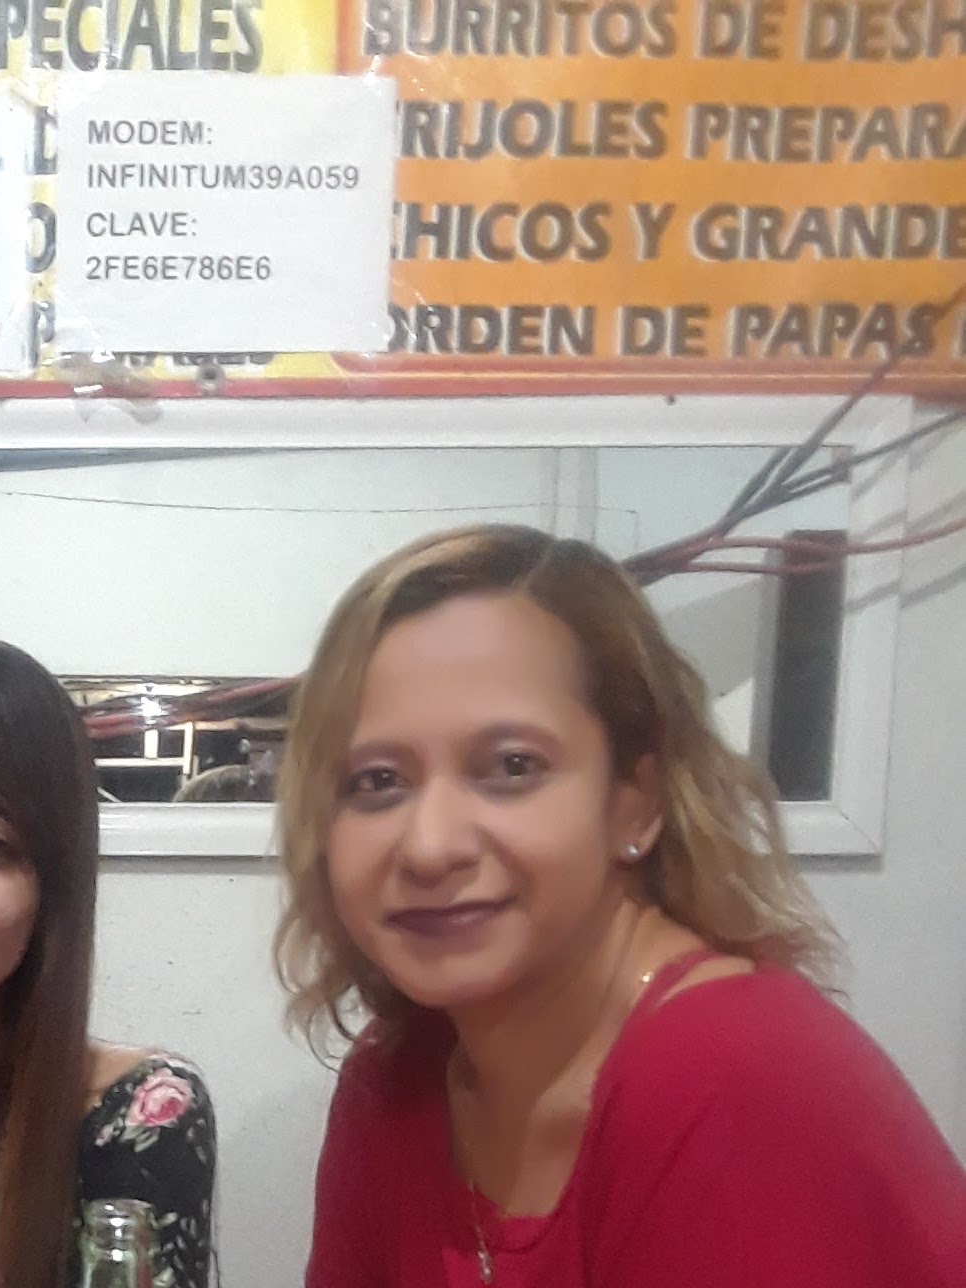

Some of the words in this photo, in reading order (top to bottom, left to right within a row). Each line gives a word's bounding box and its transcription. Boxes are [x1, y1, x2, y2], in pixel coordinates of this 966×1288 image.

[364, 0, 679, 56] BURRITOS
[698, 0, 782, 58] DE
[87, 120, 213, 145] MODEM:
[395, 99, 669, 158] RIJOLES
[87, 163, 360, 190] INFINITUM39A059
[86, 211, 197, 237] CLAVE:
[388, 201, 612, 260] HICOS
[635, 204, 673, 259] Y
[85, 255, 272, 281] 2FE6E786E6
[620, 305, 706, 356] DE
[731, 303, 935, 358] PAPAS
